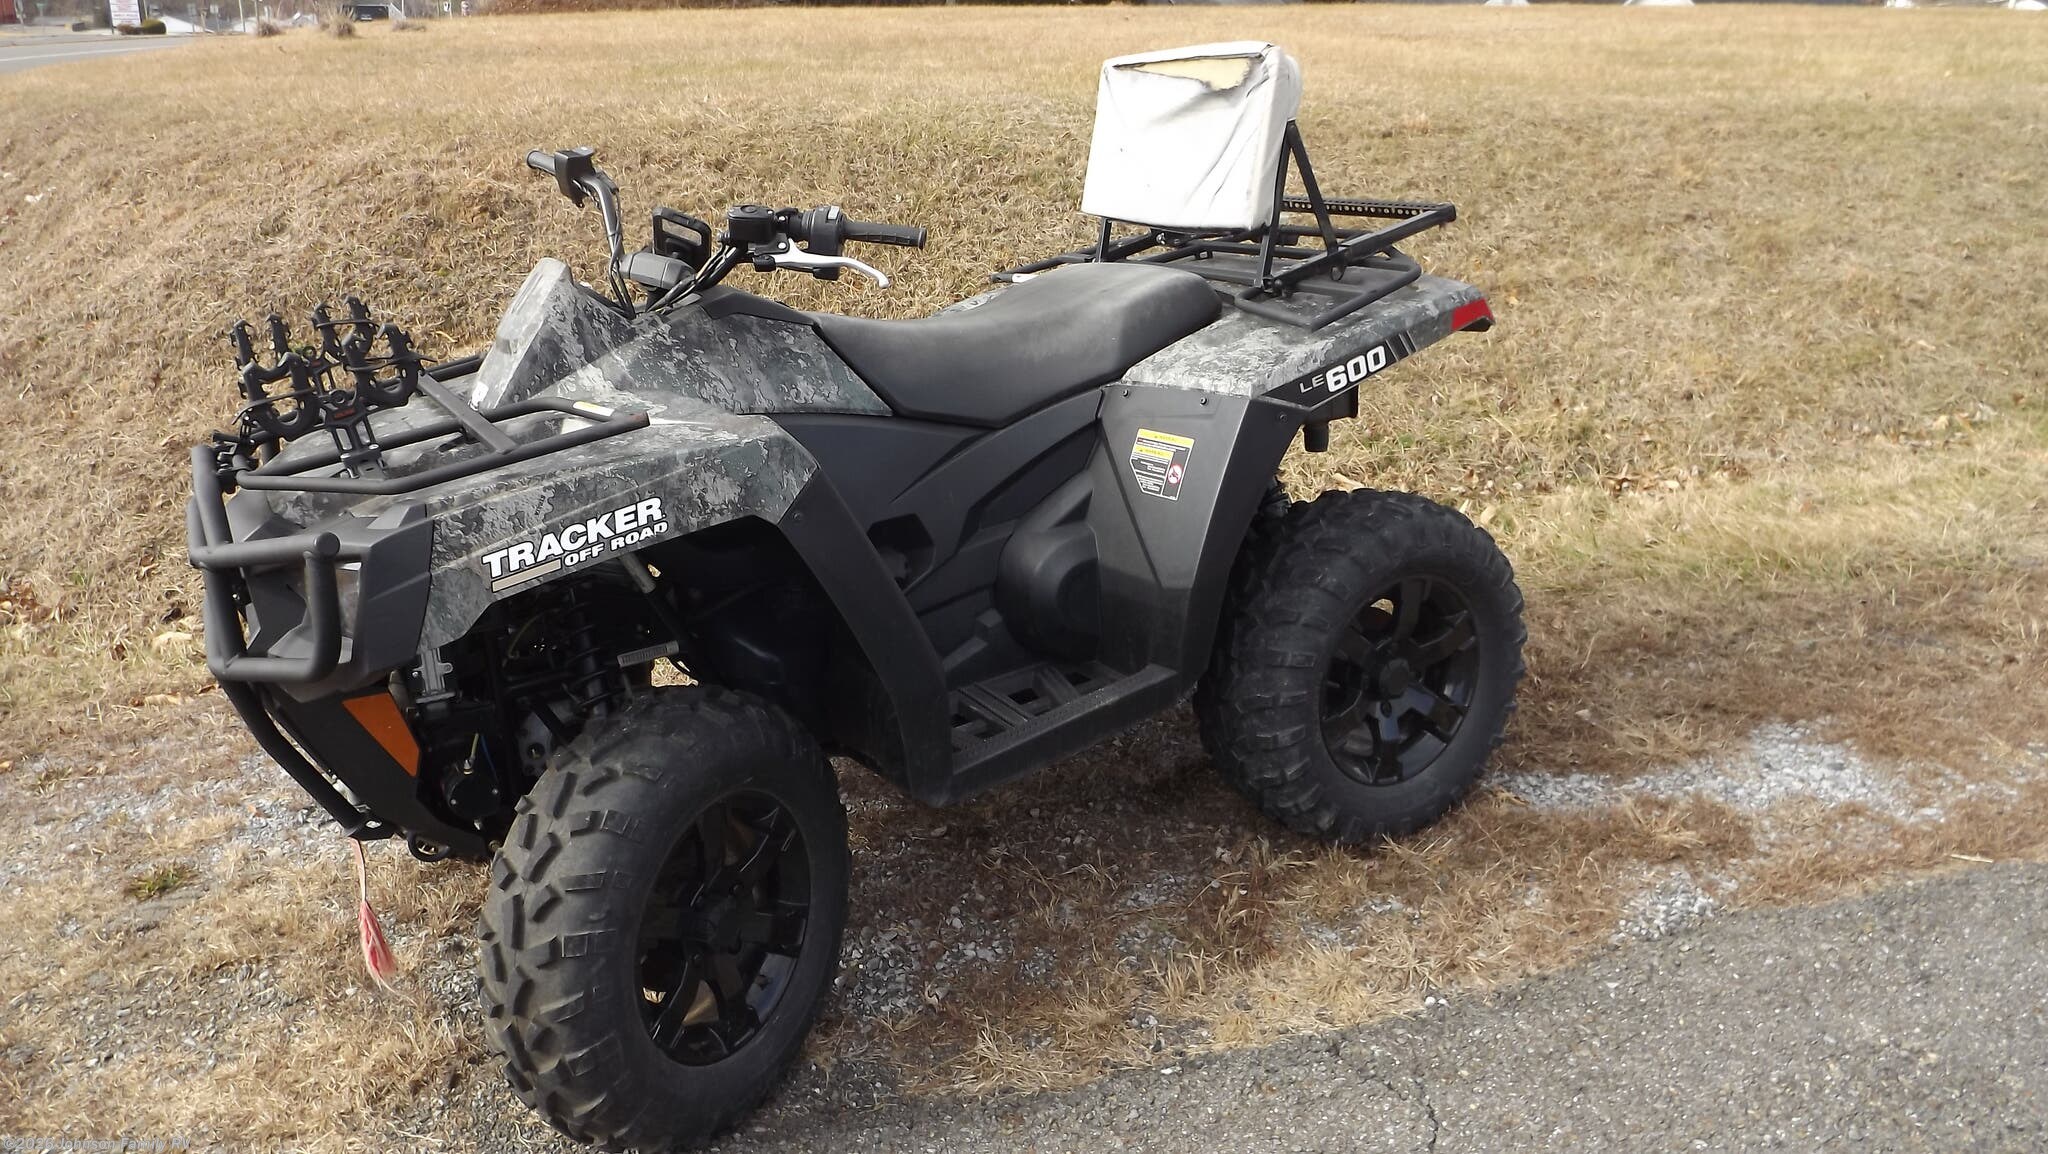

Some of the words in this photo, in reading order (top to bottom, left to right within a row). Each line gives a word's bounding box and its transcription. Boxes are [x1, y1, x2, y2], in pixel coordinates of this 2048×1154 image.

[1299, 373, 1325, 394] LE
[1325, 345, 1387, 393] 600
[481, 497, 664, 578] TRACKER
[564, 543, 604, 567] OFF
[611, 522, 668, 551] ROAD
